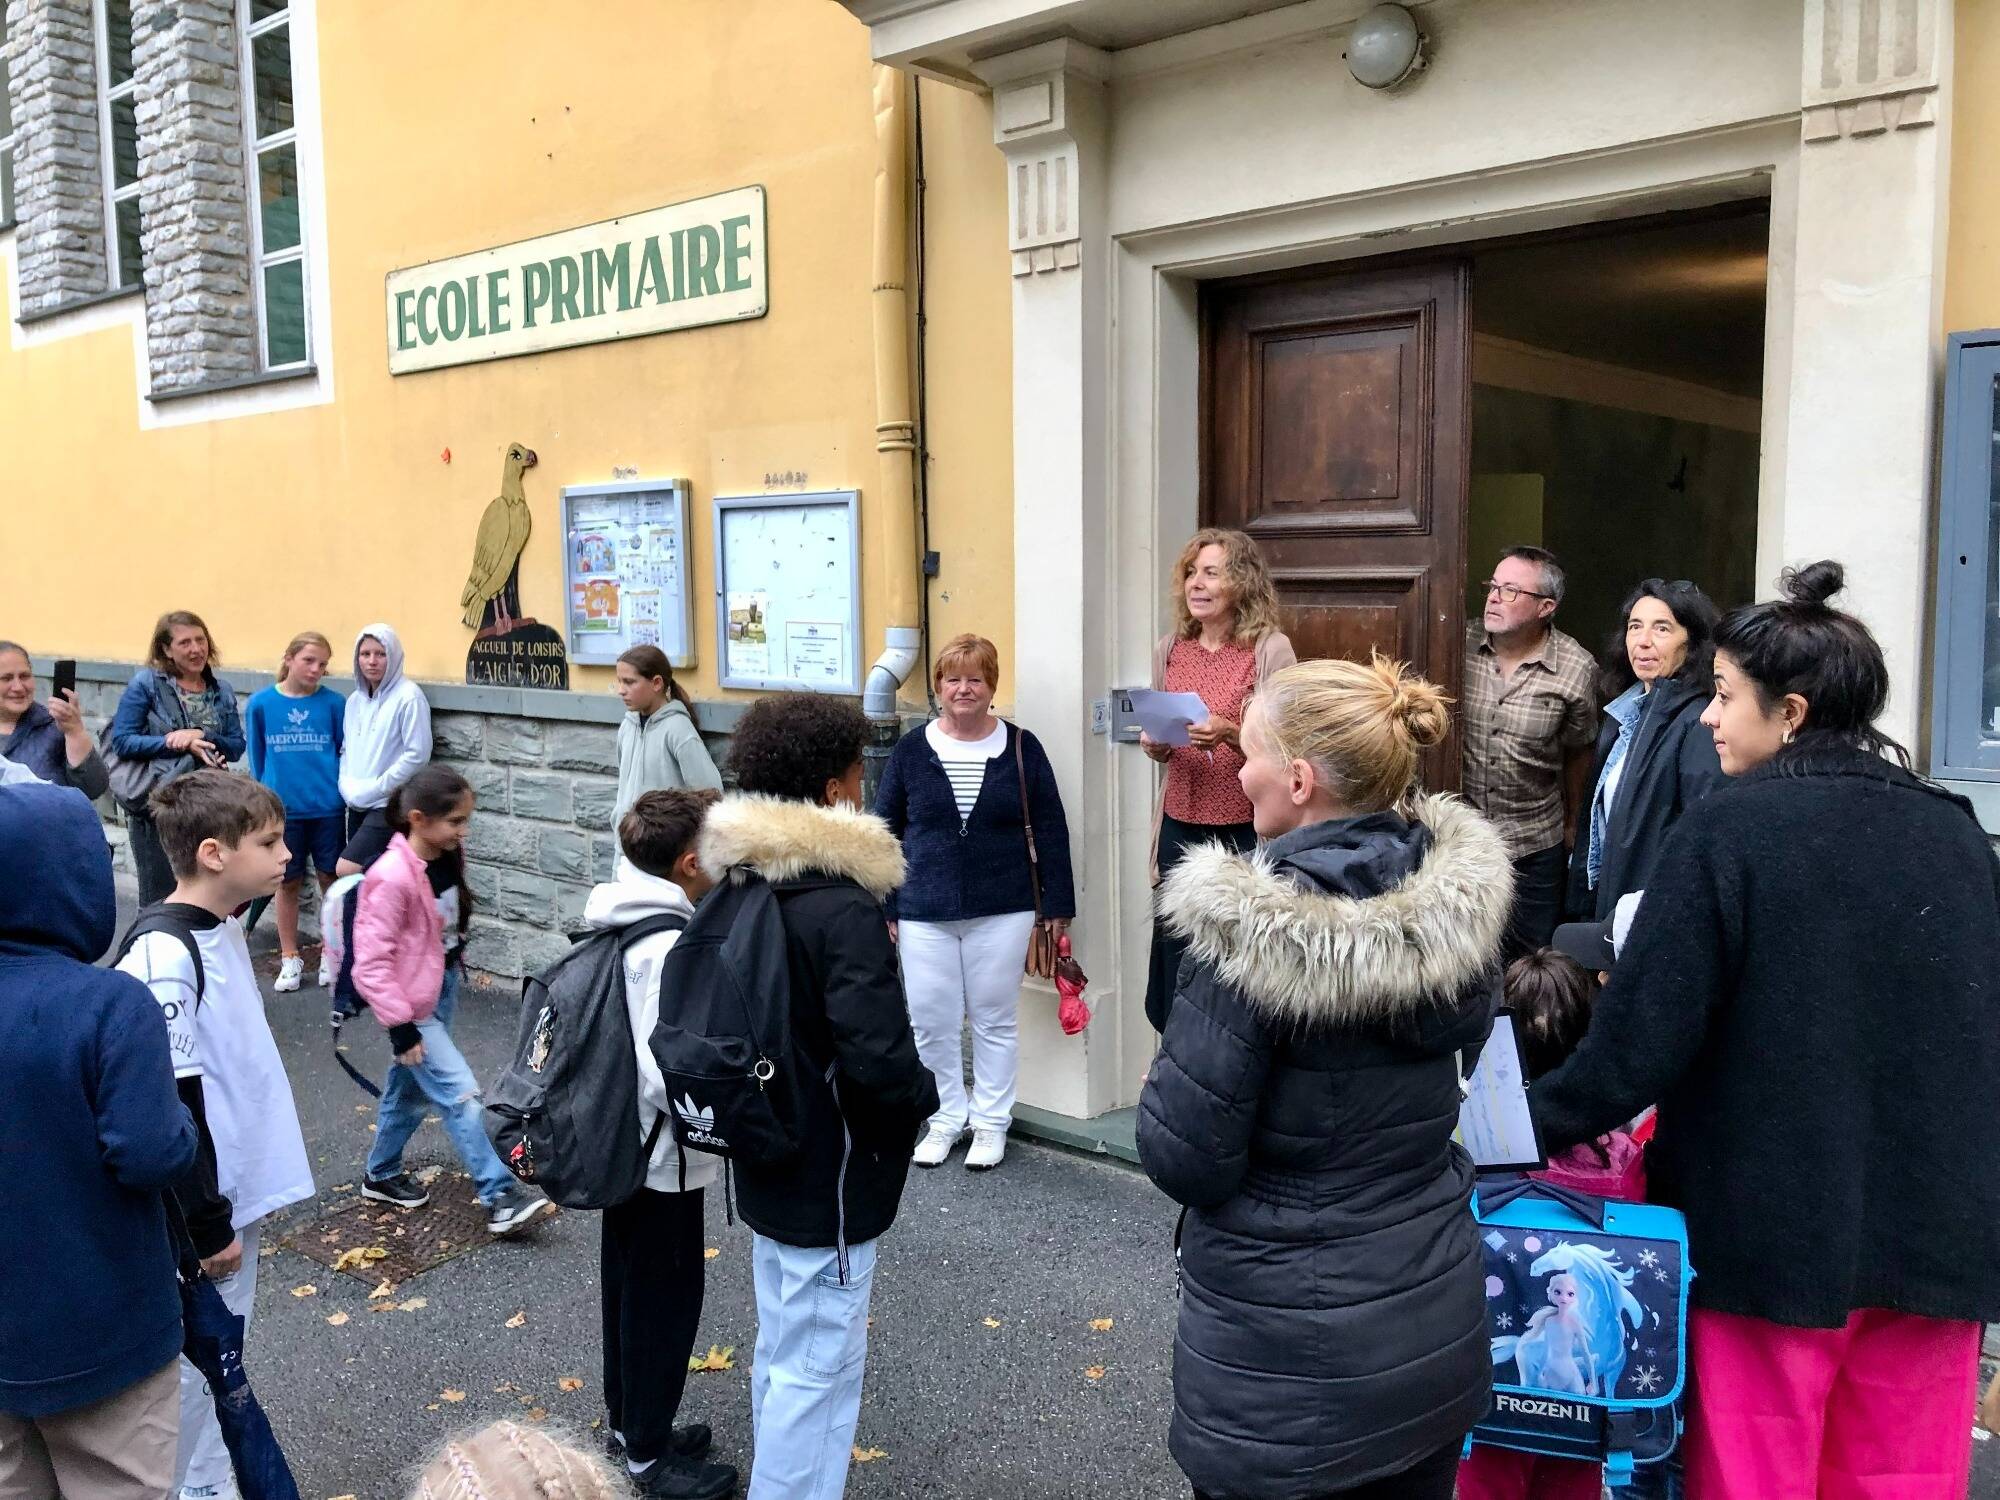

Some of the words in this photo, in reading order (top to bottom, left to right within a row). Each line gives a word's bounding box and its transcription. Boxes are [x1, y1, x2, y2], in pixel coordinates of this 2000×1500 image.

[395, 269, 511, 351] ECOLE
[521, 214, 752, 328] PRIMAIRE
[473, 640, 509, 655] ACCUEIL
[513, 641, 525, 656] DE
[528, 641, 564, 658] LOISIRS
[530, 663, 561, 687] D'OR
[161, 999, 187, 1021] OY
[687, 1130, 729, 1148] adidas
[1496, 1394, 1573, 1420] FROZEN
[1575, 1404, 1591, 1424] II
